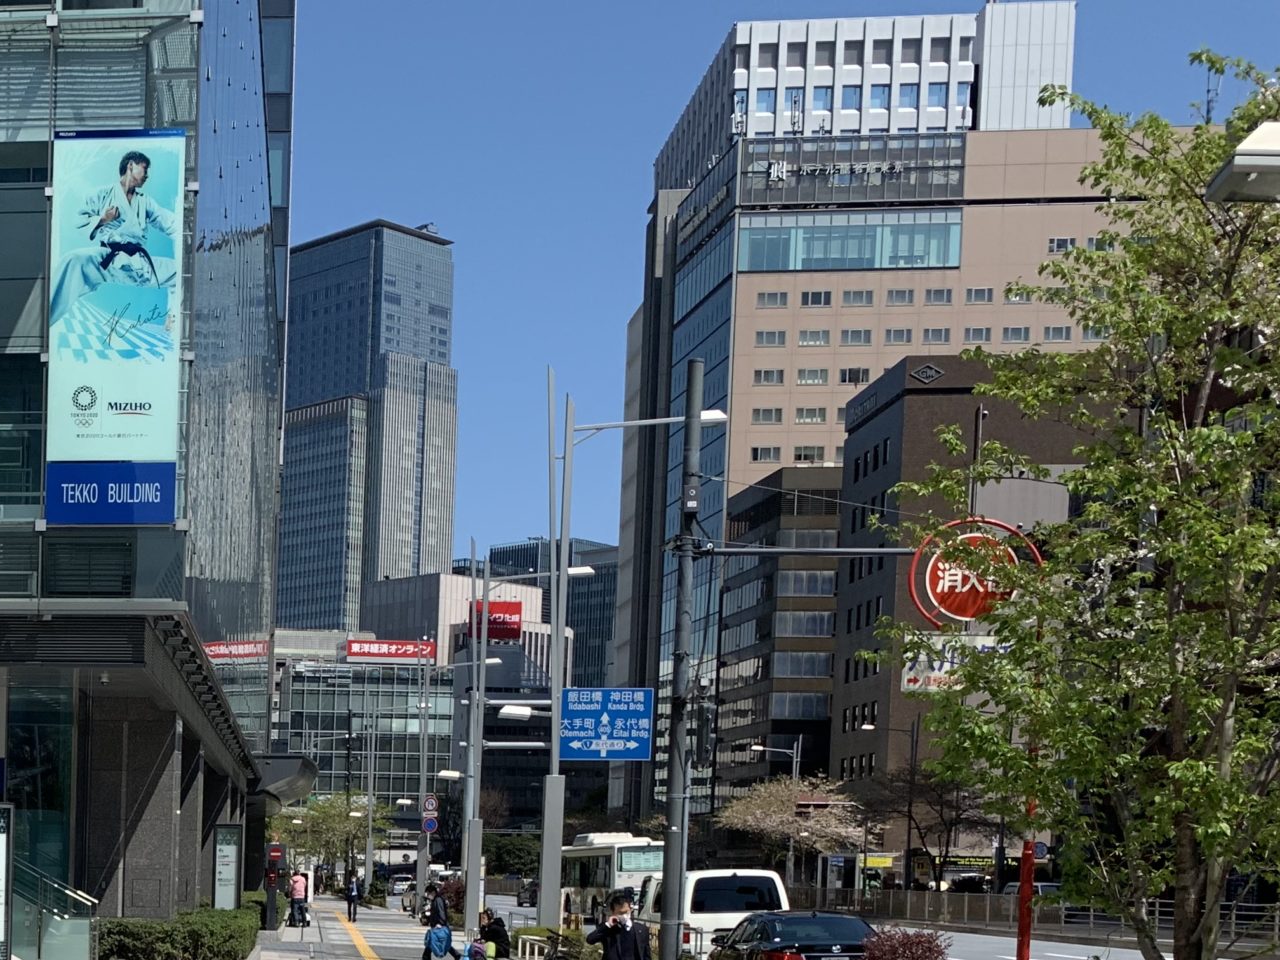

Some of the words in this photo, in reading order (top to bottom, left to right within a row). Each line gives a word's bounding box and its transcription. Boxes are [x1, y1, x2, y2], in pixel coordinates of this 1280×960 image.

[102, 302, 170, 347] Karate
[106, 401, 152, 412] MIZUHO
[61, 483, 99, 504] TEKKO
[107, 482, 161, 503] BUILDING
[350, 642, 432, 655] 東洋経済オンライン
[567, 691, 603, 702] 飯田橋
[609, 691, 645, 702] 神田橋
[568, 702, 601, 711] Iidabashi
[607, 703, 628, 711] Kanda
[628, 703, 645, 711] Brdg.
[560, 718, 595, 729] 大手町
[614, 718, 650, 729] 永代橋
[560, 729, 595, 737] Otemachi
[631, 730, 650, 739] Brdg.
